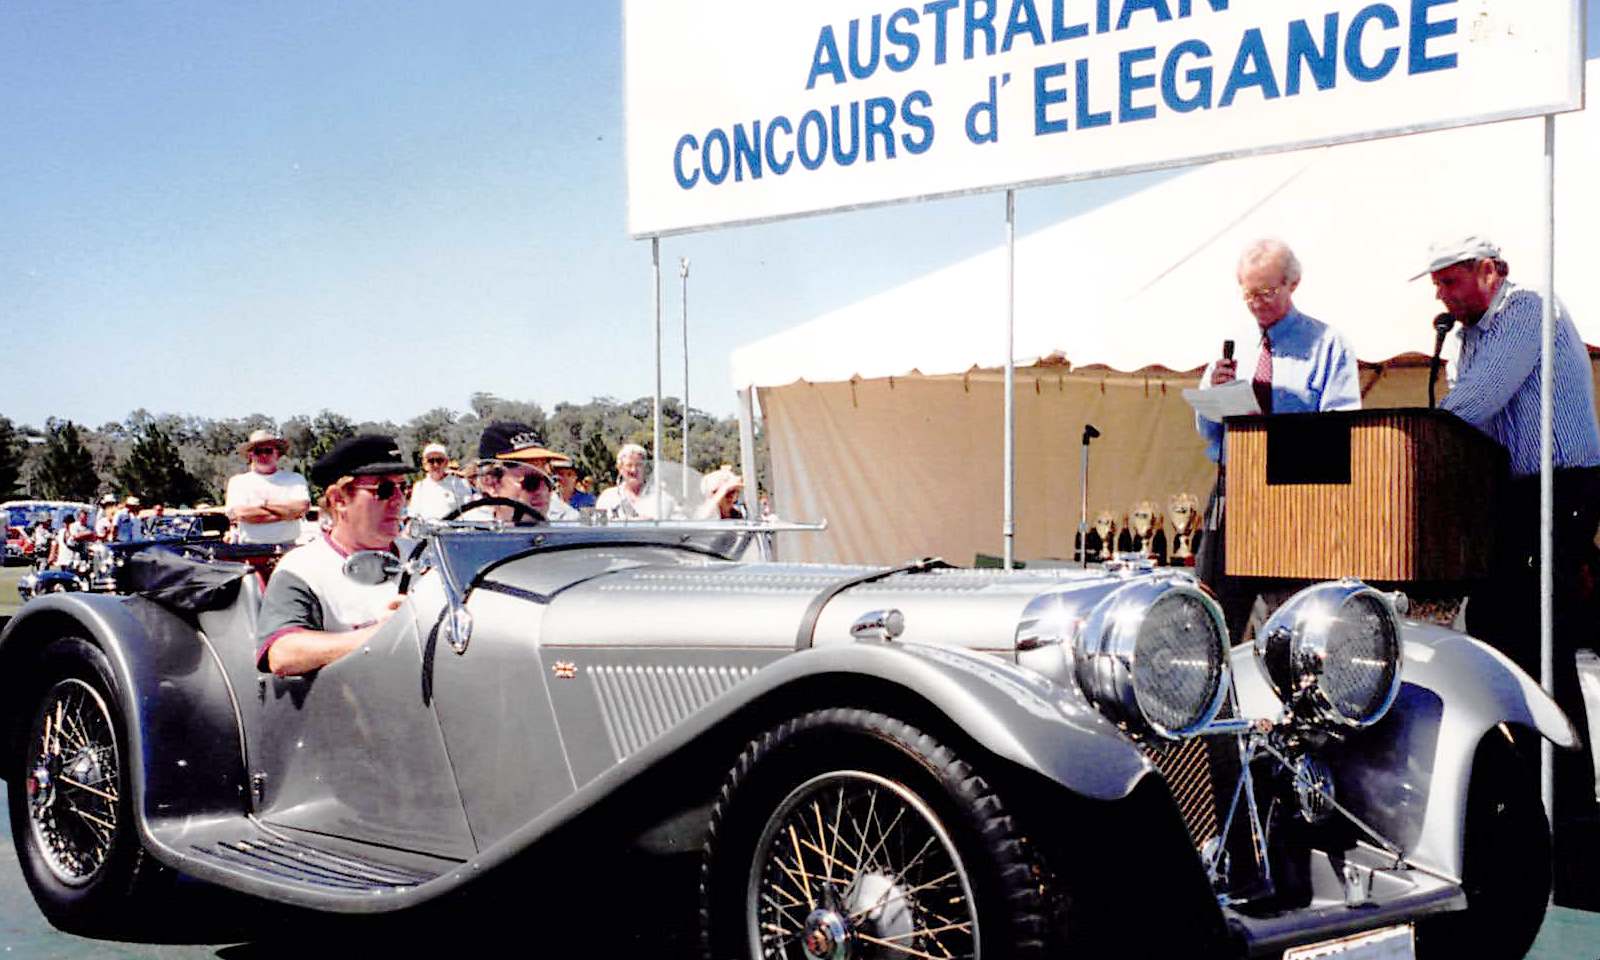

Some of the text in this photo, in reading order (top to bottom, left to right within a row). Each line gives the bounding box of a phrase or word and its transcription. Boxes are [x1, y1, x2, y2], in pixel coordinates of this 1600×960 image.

[673, 90, 935, 190] CONCOURS
[1034, 0, 1459, 136] ELEGANCE
[804, 0, 1230, 89] AUSTRALI
